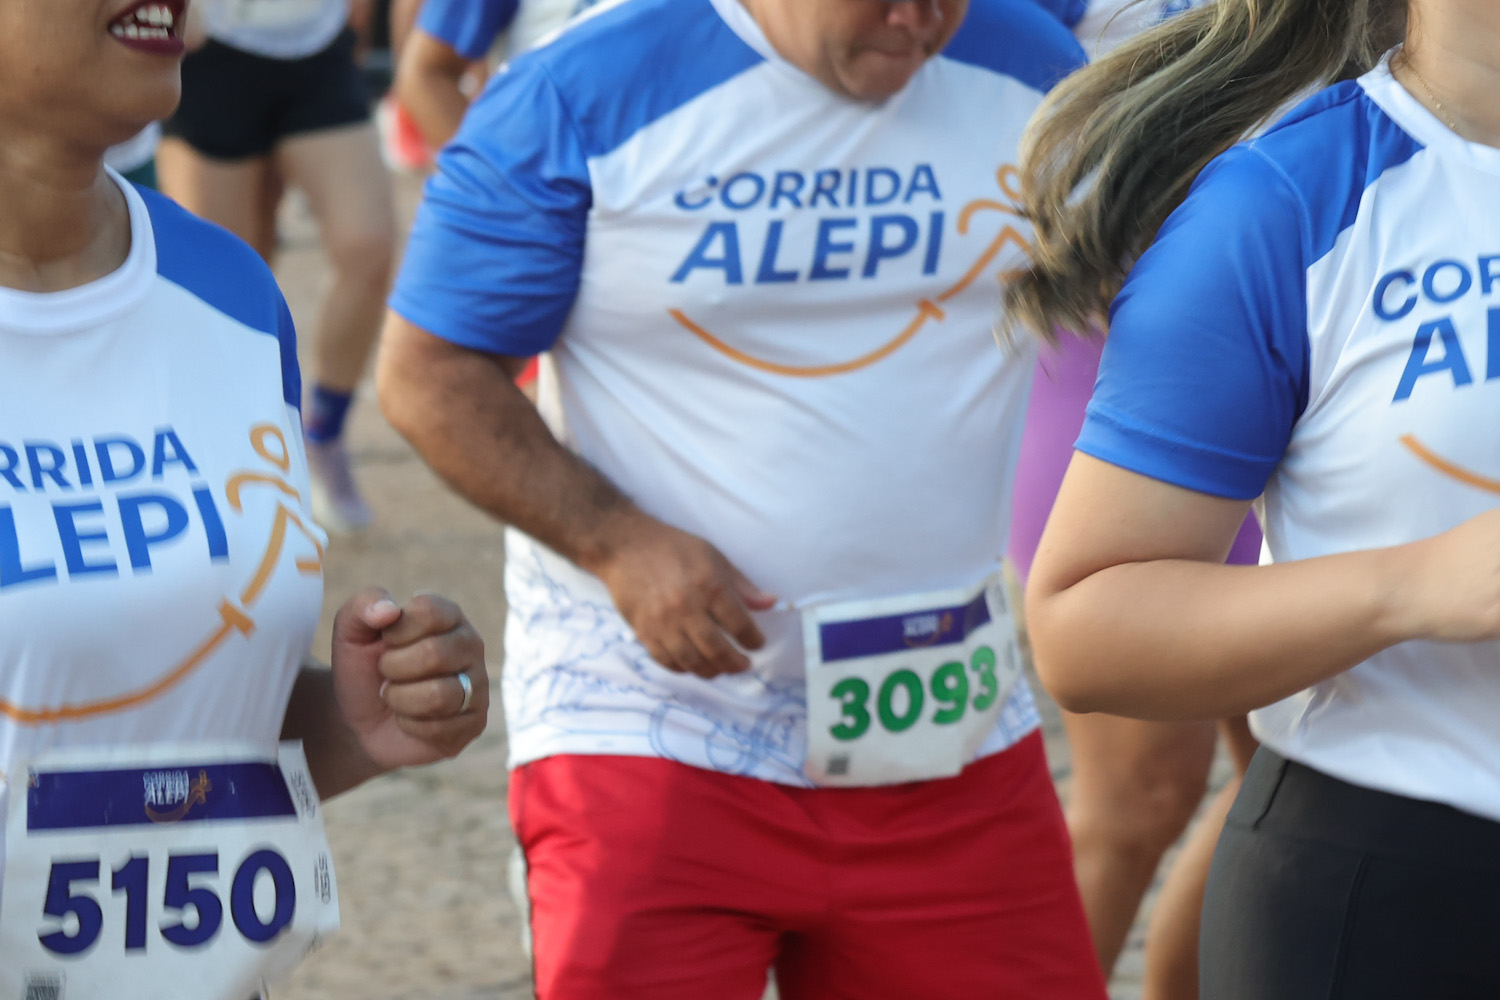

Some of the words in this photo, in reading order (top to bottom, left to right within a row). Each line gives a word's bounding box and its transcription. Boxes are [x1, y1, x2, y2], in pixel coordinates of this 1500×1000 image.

[673, 163, 943, 211] CORRIDA
[668, 210, 946, 286] ALEPI
[828, 644, 999, 742] 3093
[36, 843, 297, 958] 5150
